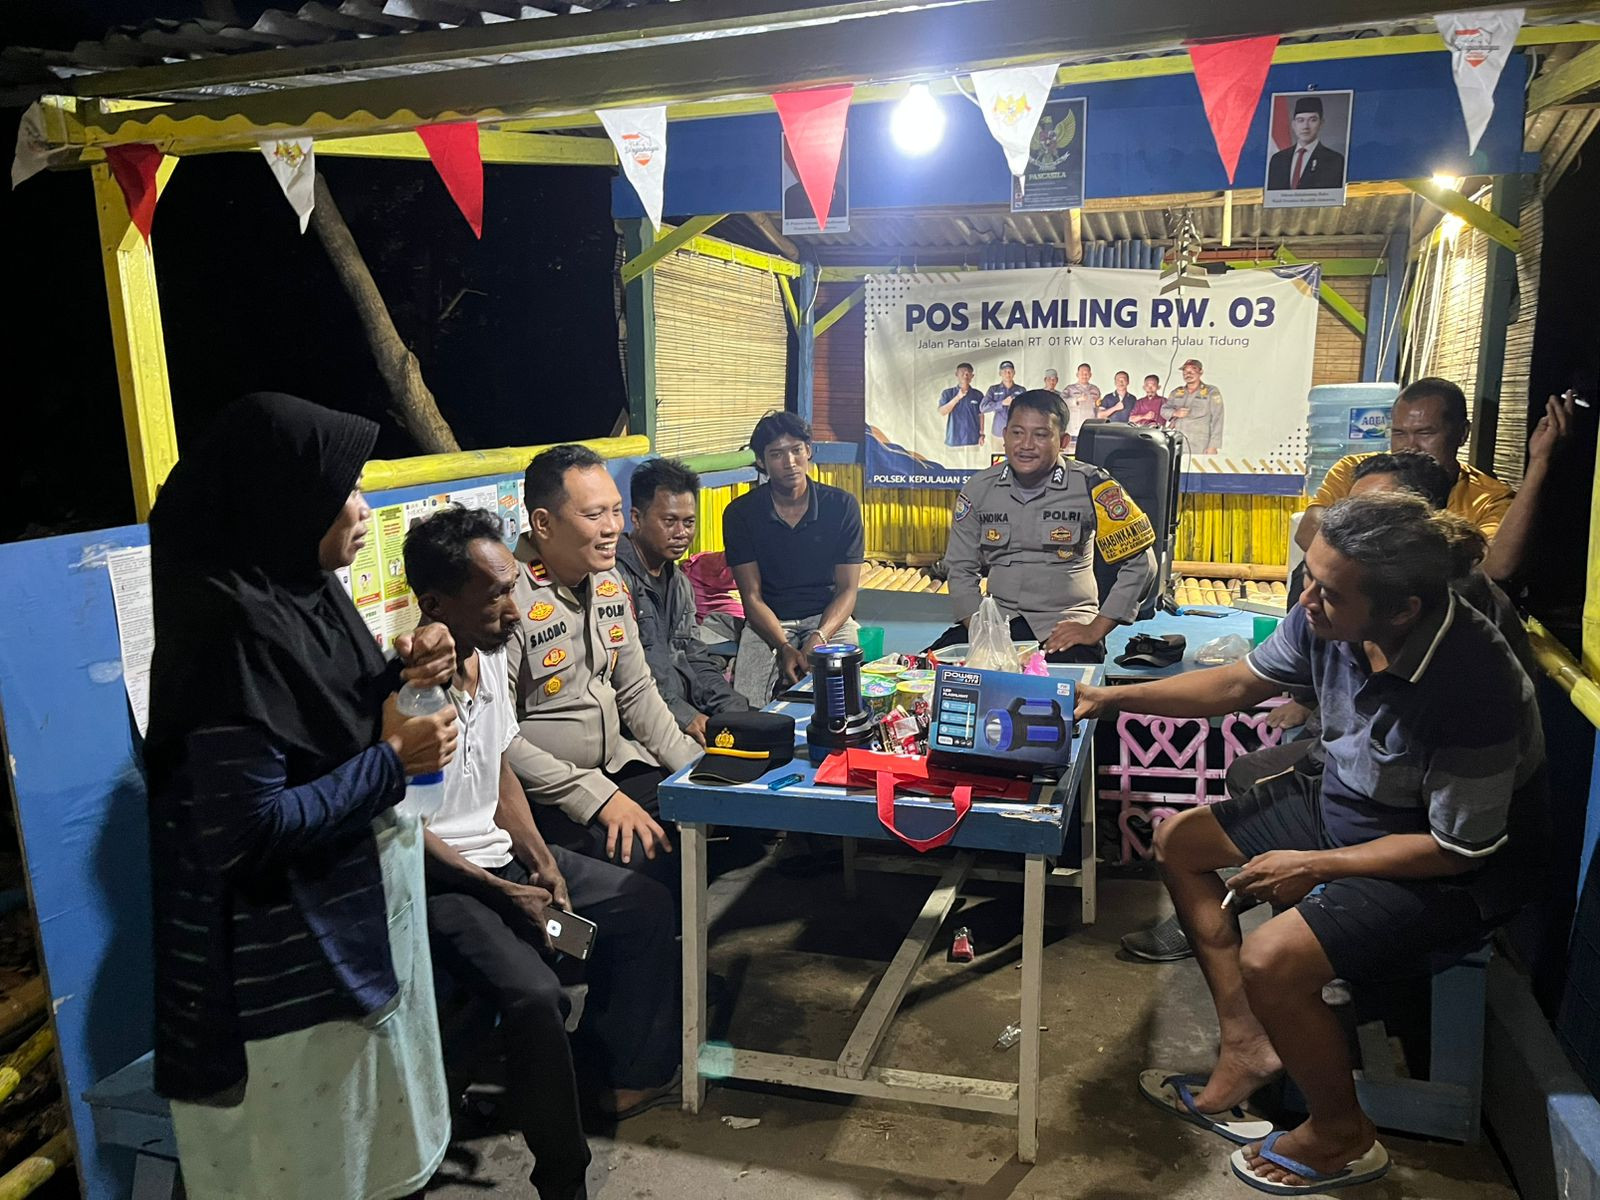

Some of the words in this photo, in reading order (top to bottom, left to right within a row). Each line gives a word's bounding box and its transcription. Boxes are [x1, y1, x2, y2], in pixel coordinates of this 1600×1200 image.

[905, 302, 970, 332] POS
[981, 298, 1138, 331] KAMLING
[1150, 298, 1215, 328] RW.
[1228, 296, 1276, 328] 03
[918, 339, 944, 349] Jalan
[947, 338, 980, 348] Pantai
[984, 337, 1024, 348] Selatan
[1048, 336, 1060, 346] 01
[1089, 336, 1105, 346] 03
[1108, 335, 1167, 346] Kelurahan
[1171, 335, 1204, 346] Pulau
[1208, 335, 1250, 348] Tidung
[873, 474, 906, 483] POLSEK
[908, 475, 960, 484] KEPULAUAN
[1042, 510, 1081, 522] POLRI
[529, 621, 567, 649] SALOMO
